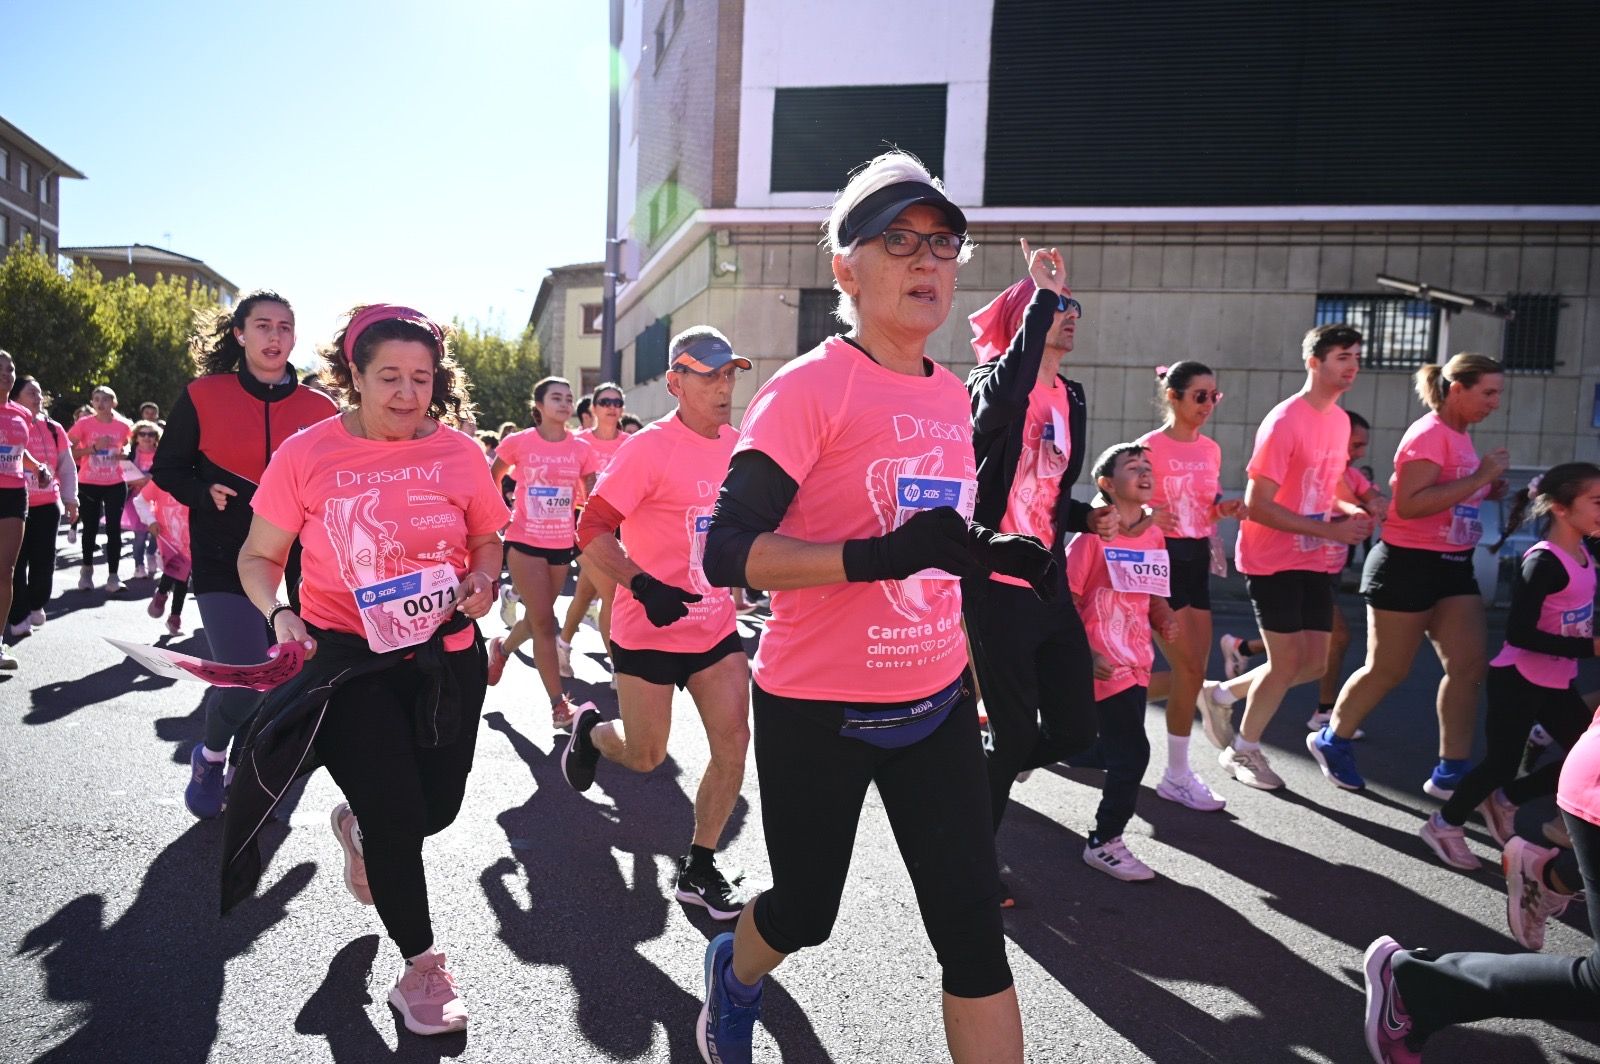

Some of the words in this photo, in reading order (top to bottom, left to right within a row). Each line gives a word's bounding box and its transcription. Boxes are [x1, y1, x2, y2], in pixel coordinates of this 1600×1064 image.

[546, 498, 571, 507] 4709
[1133, 564, 1168, 578] 0763
[403, 586, 456, 617] 0071
[867, 624, 933, 640] Carrera
[937, 616, 952, 632] de
[867, 643, 919, 655] almom
[866, 660, 912, 669] Contra
[917, 656, 928, 666] el
